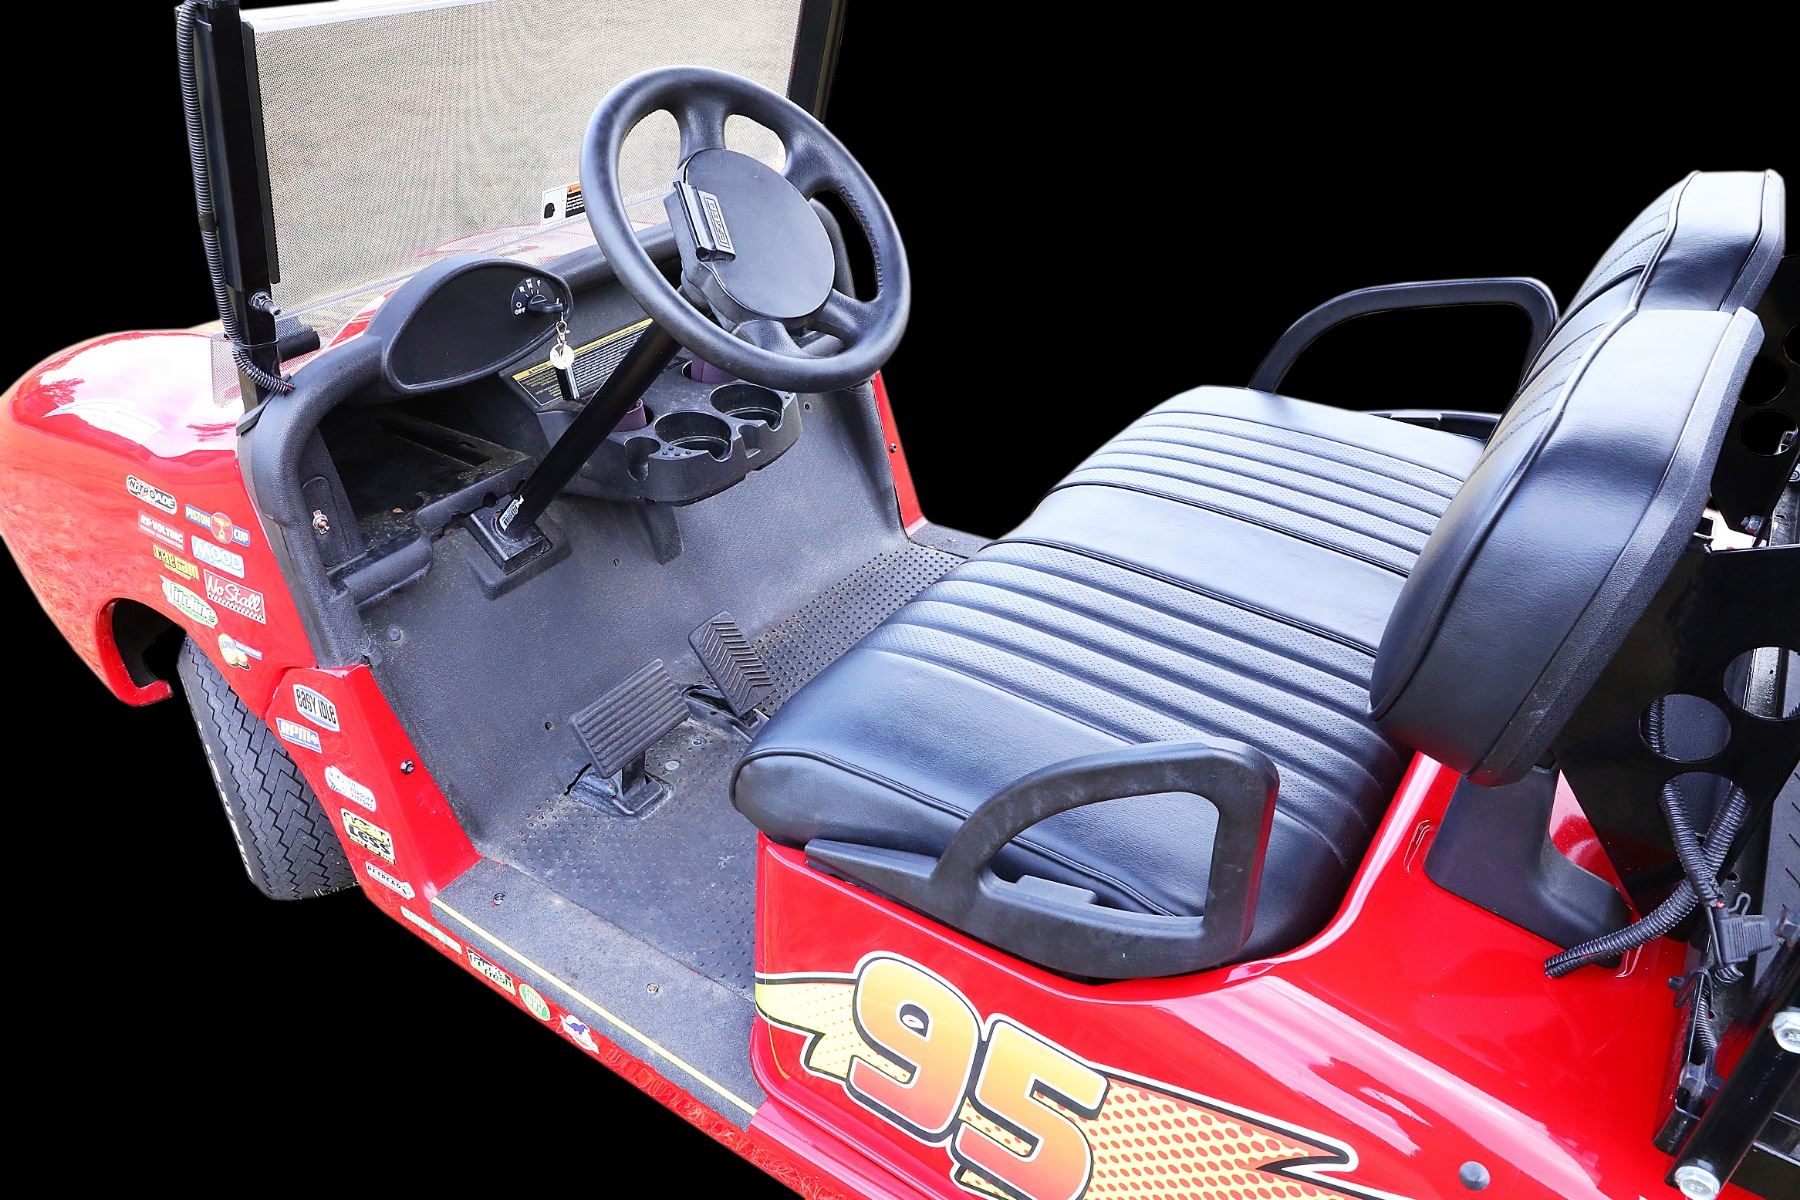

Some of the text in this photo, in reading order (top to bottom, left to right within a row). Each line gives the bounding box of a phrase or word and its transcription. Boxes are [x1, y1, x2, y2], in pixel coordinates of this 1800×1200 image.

[515, 307, 525, 315] OFF
[185, 505, 249, 543] PISTON CUP
[207, 575, 261, 612] No Stall
[848, 951, 1111, 1200] 95
